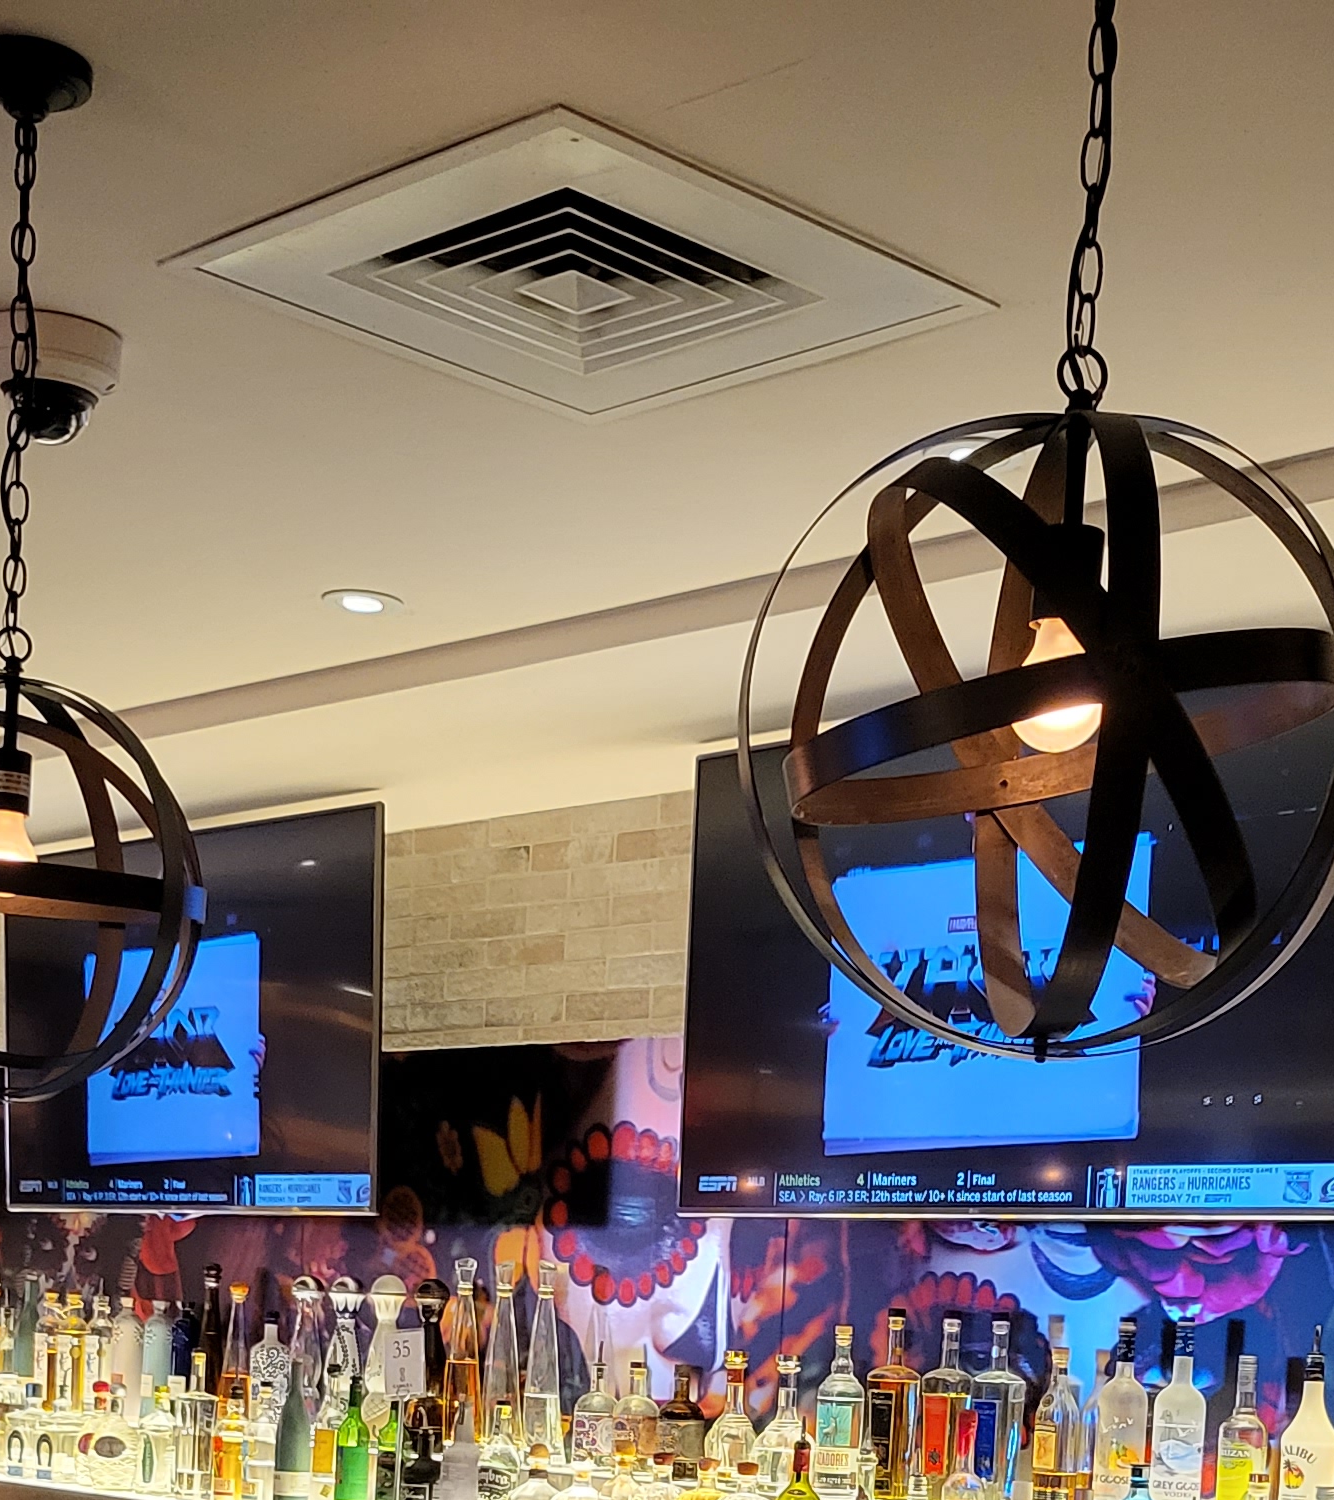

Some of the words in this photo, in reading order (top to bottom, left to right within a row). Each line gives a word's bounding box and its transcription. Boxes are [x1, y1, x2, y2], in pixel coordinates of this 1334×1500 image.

[868, 1025, 939, 1068] LOVE
[698, 1175, 738, 1192] ESPN
[779, 1174, 821, 1187] Athletics
[857, 1173, 865, 1186] 4
[872, 1173, 917, 1186] Mariners
[957, 1172, 965, 1186] 2
[972, 1174, 996, 1186] Final
[1131, 1176, 1176, 1191] RANGERS
[1187, 1176, 1251, 1191] HURRICANES
[778, 1190, 796, 1202] SEA
[828, 1190, 835, 1201] 6
[847, 1191, 853, 1202] 3
[871, 1190, 891, 1202] 12th
[892, 1190, 913, 1202] start
[947, 1191, 955, 1202] K
[956, 1190, 980, 1202] since
[982, 1190, 1005, 1203] start
[1006, 1190, 1017, 1203] of
[1018, 1190, 1036, 1203] last
[1037, 1192, 1072, 1203] season
[1131, 1193, 1184, 1204] THURSDAY
[1204, 1194, 1232, 1203] ESPN
[392, 1340, 411, 1359] 35
[1153, 1480, 1174, 1490] GREY
